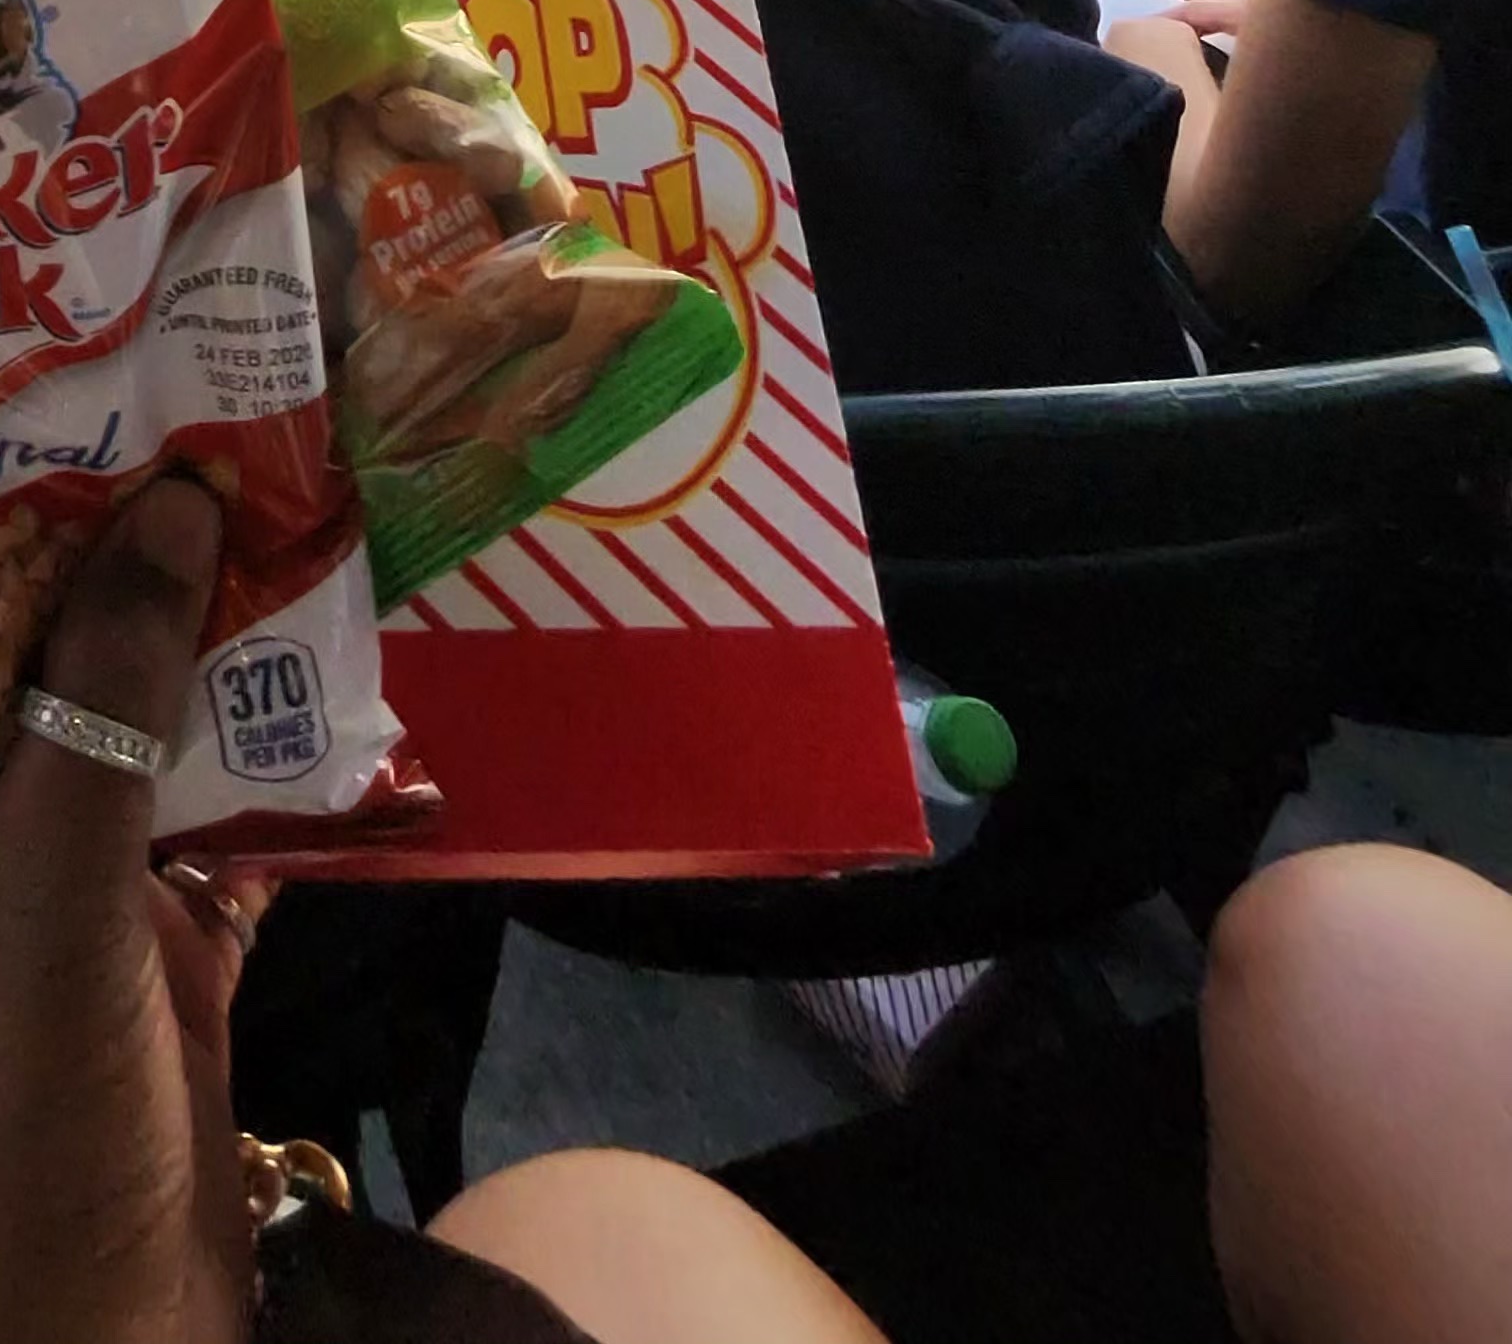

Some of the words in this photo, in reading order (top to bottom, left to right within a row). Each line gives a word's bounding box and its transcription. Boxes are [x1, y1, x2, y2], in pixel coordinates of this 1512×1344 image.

[386, 180, 432, 220] 7g
[370, 192, 482, 274] Protein
[157, 266, 259, 317] GUARANTEED
[275, 310, 310, 332] DATE
[194, 343, 215, 363] 24
[219, 347, 262, 368] FEB
[222, 652, 309, 722] 370
[234, 708, 316, 748] CALORIES
[242, 744, 276, 770] PER
[280, 736, 317, 763] PKG
